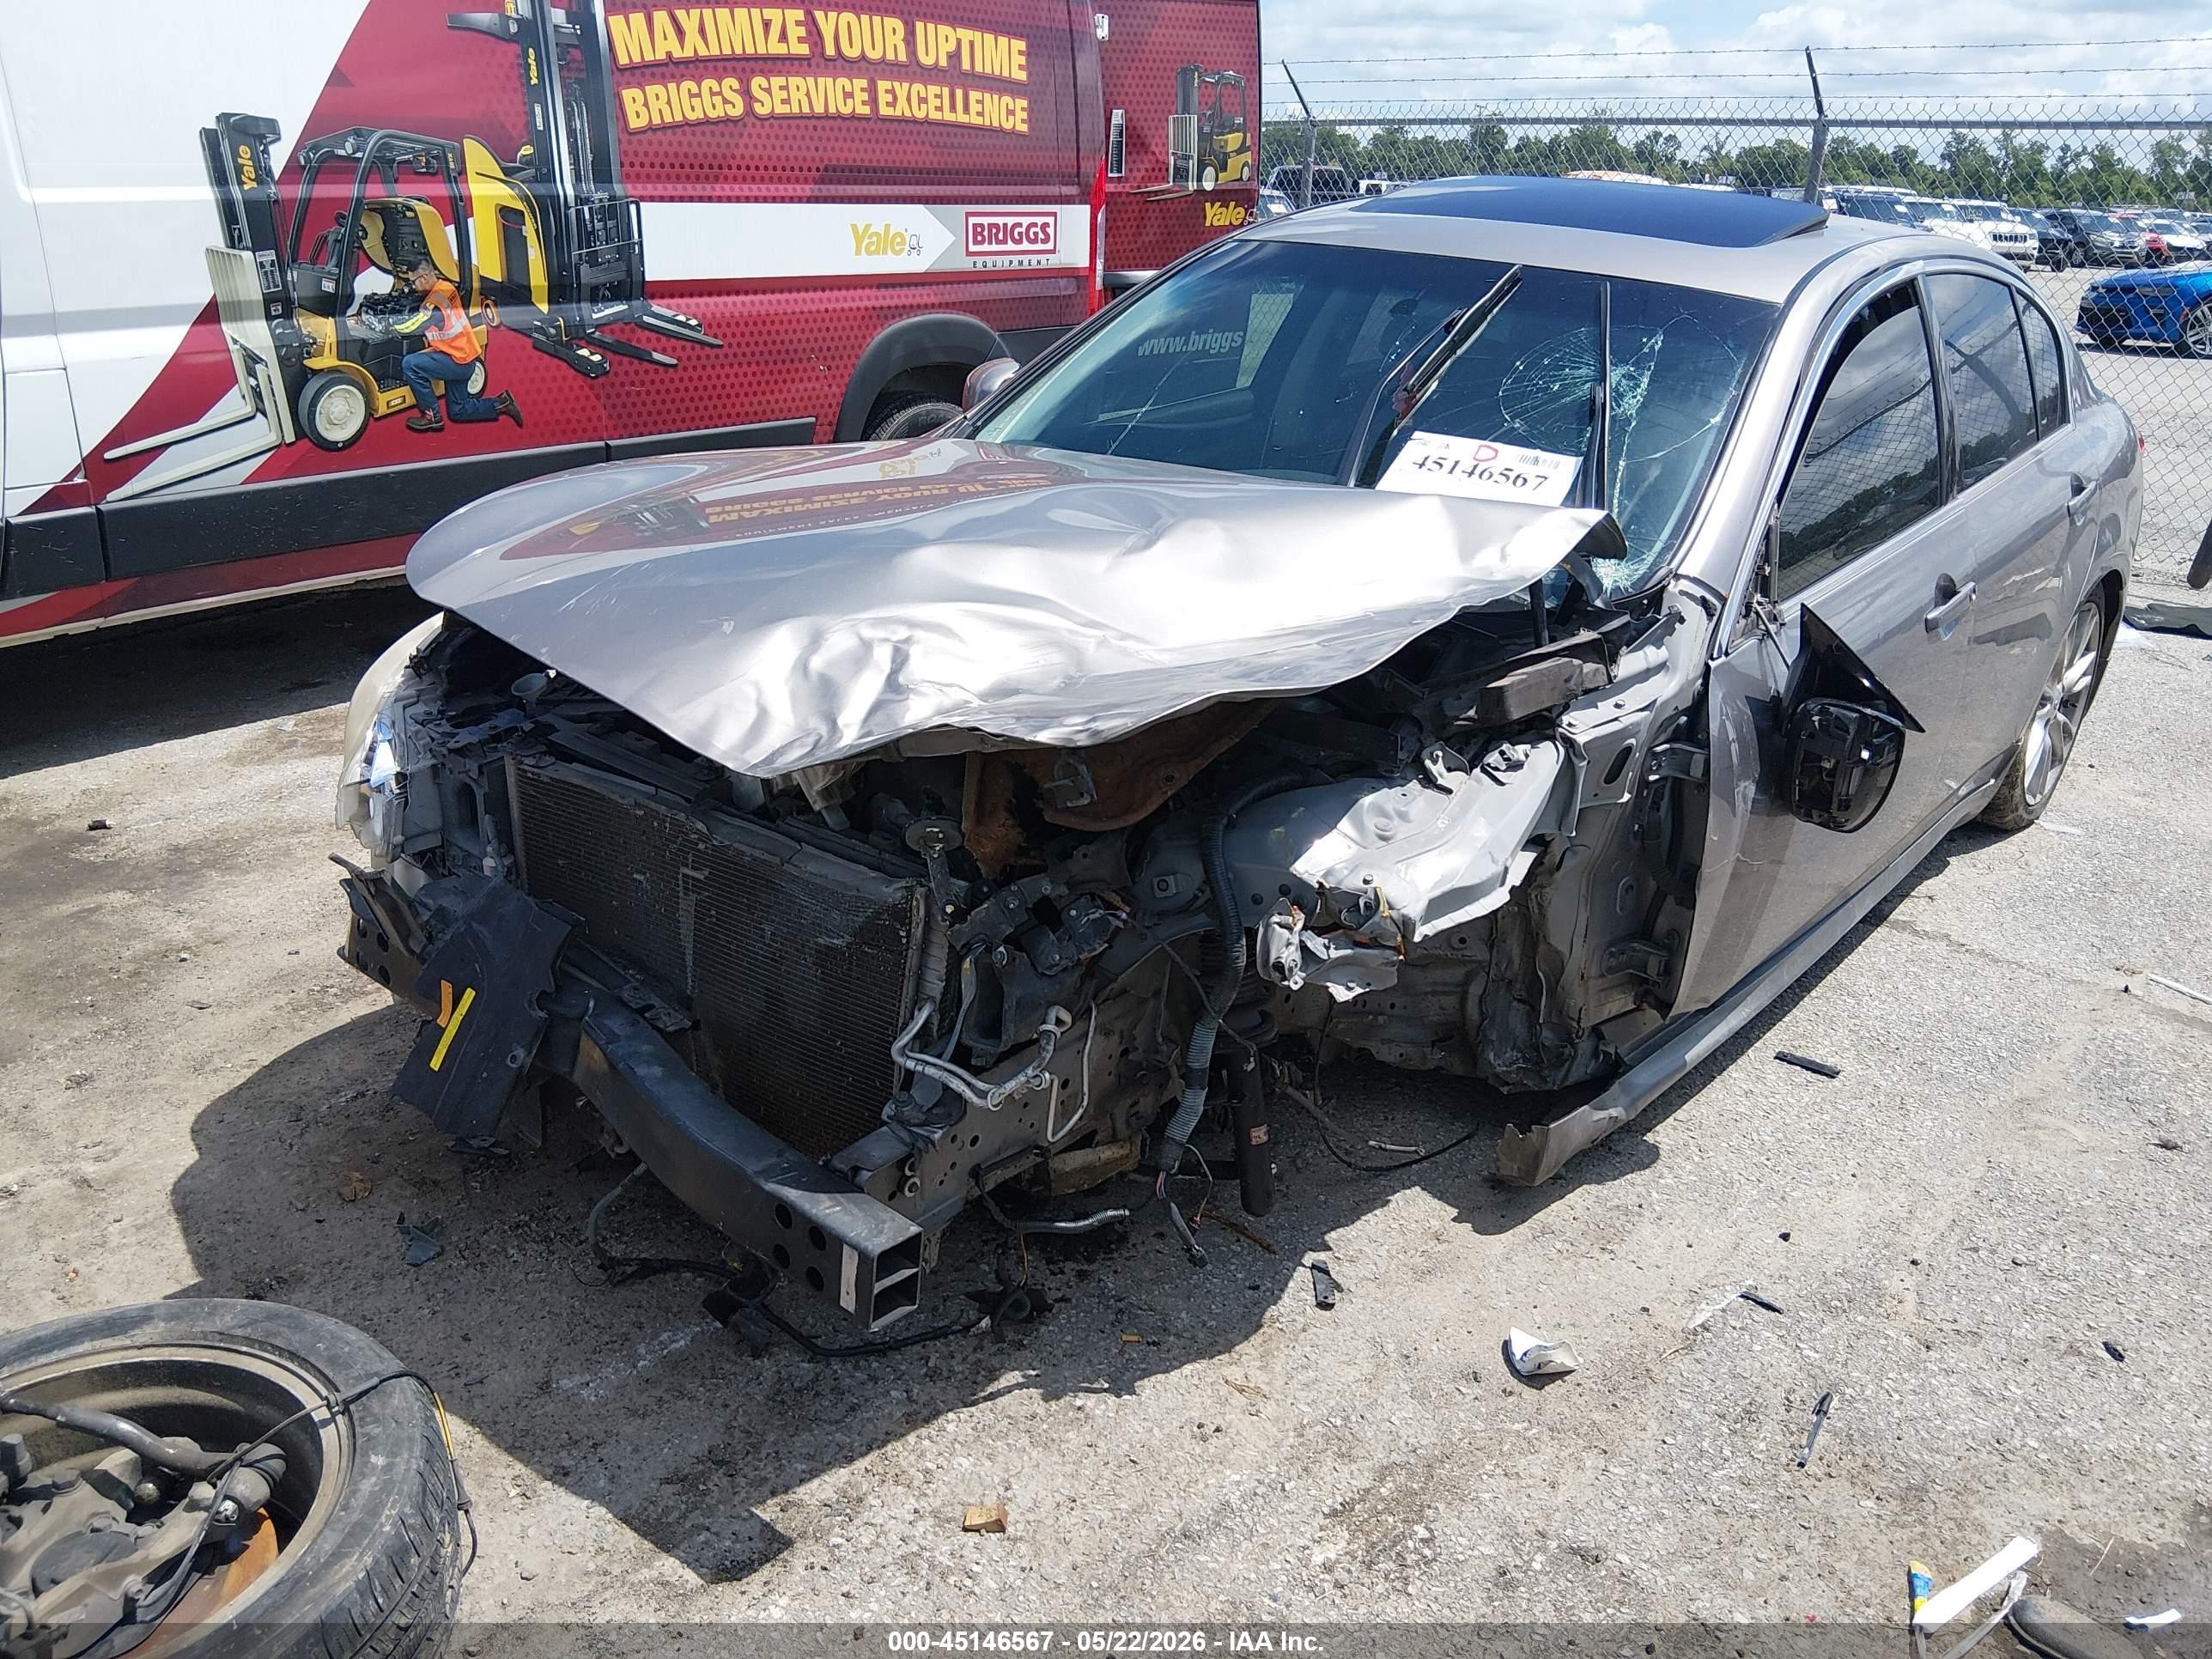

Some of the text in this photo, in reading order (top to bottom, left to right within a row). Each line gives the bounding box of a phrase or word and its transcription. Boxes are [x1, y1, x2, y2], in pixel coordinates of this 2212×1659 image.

[607, 7, 811, 65] MAXIMIZE
[812, 11, 908, 63] YOUR
[915, 20, 1028, 82] UPTIME
[528, 47, 538, 85] Yale
[621, 76, 1030, 132] BRIGGS SERVICE EXCELLENCE
[238, 144, 258, 191] Yale
[1204, 202, 1246, 227] Yale
[848, 222, 907, 257] Yale
[971, 222, 1051, 246] BRIGGS
[972, 258, 1051, 269] EQUIPMENT
[1137, 329, 1244, 357] www.briggs
[1412, 454, 1550, 492] 45146567
